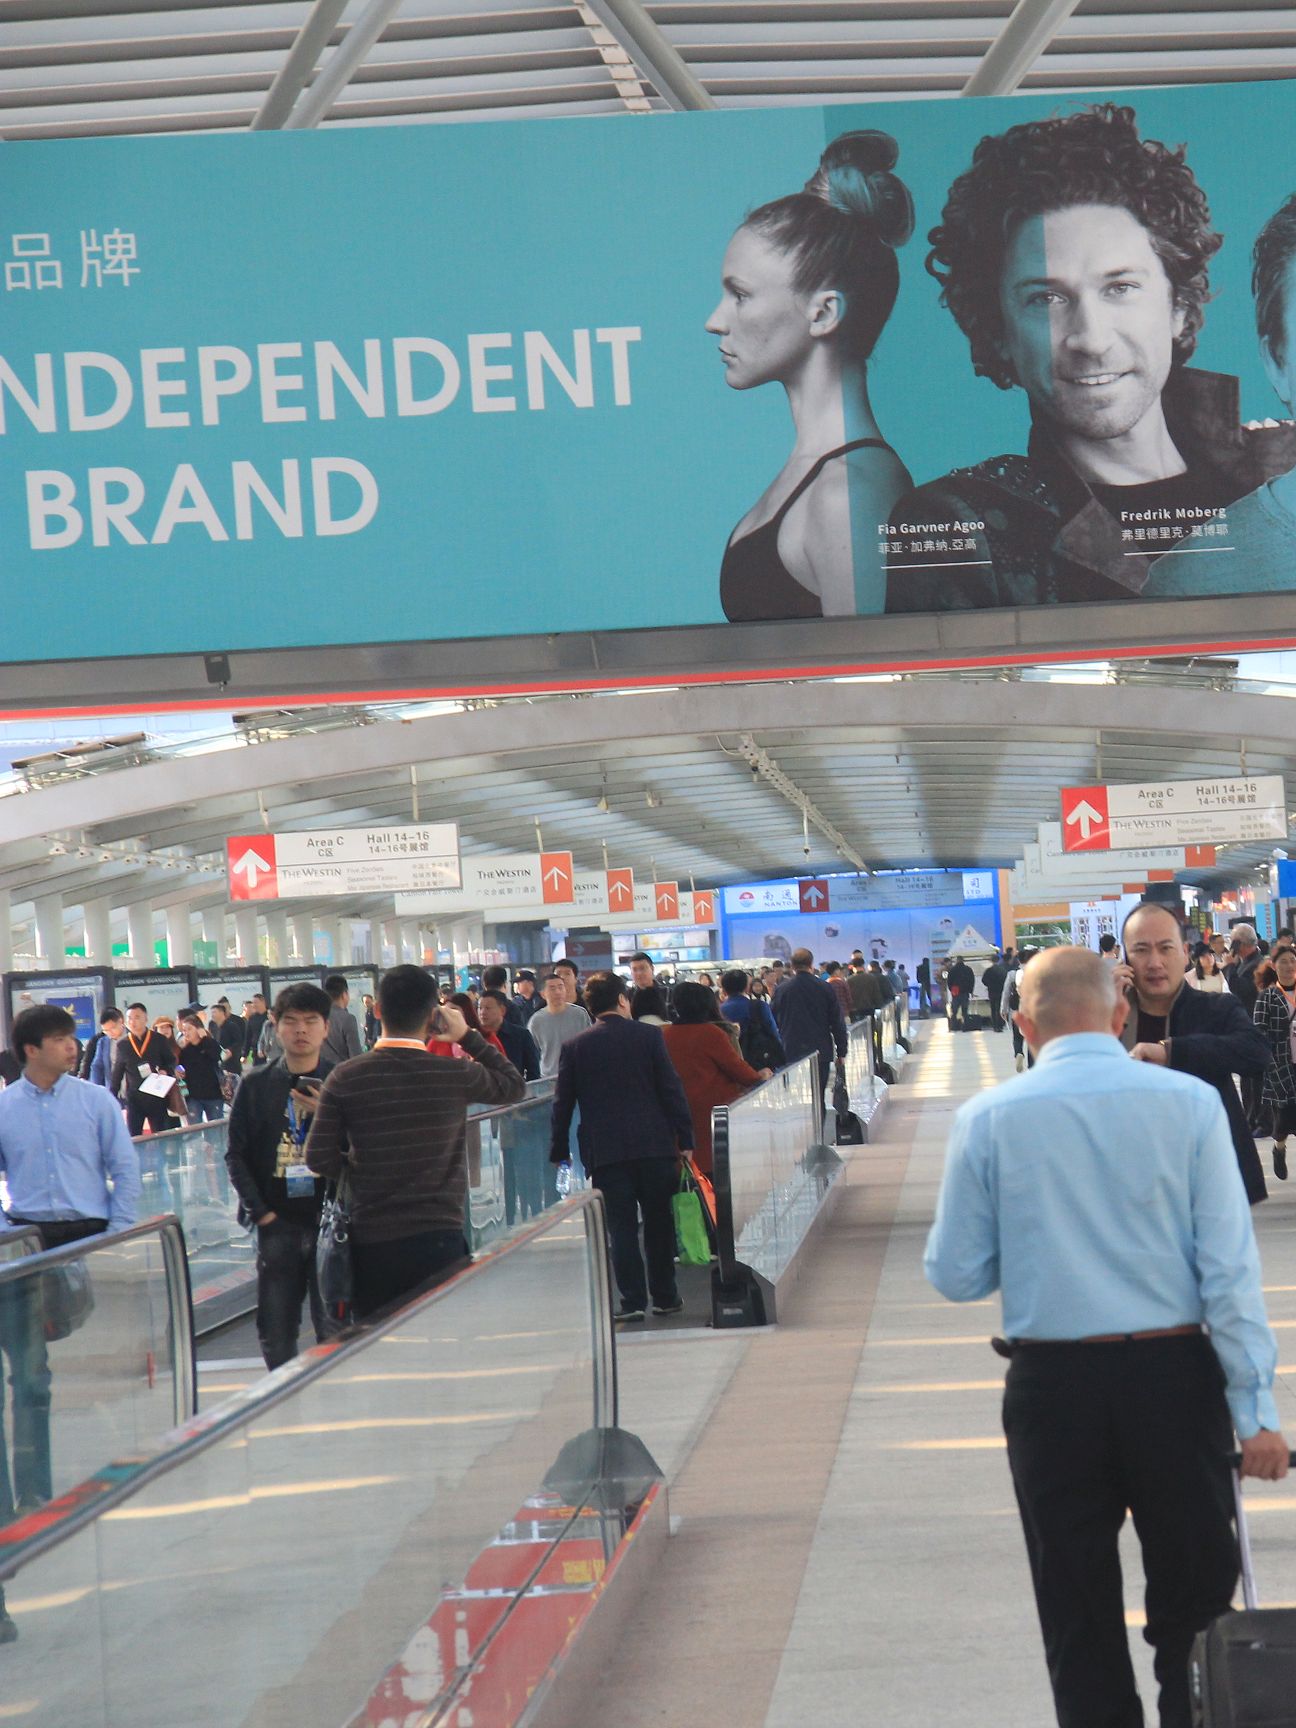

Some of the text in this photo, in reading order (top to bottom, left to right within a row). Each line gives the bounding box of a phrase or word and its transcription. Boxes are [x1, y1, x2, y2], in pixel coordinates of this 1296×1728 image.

[5, 227, 141, 290] 品牌
[25, 457, 378, 550] BRAND
[1121, 507, 1226, 521] Fredrik Moberg
[878, 521, 985, 535] Fia Garvner Agoo
[1138, 788, 1174, 799] Area C
[1196, 783, 1257, 796] Hall 14-16
[307, 836, 344, 848] Area C
[367, 831, 430, 843] Hall 14-16
